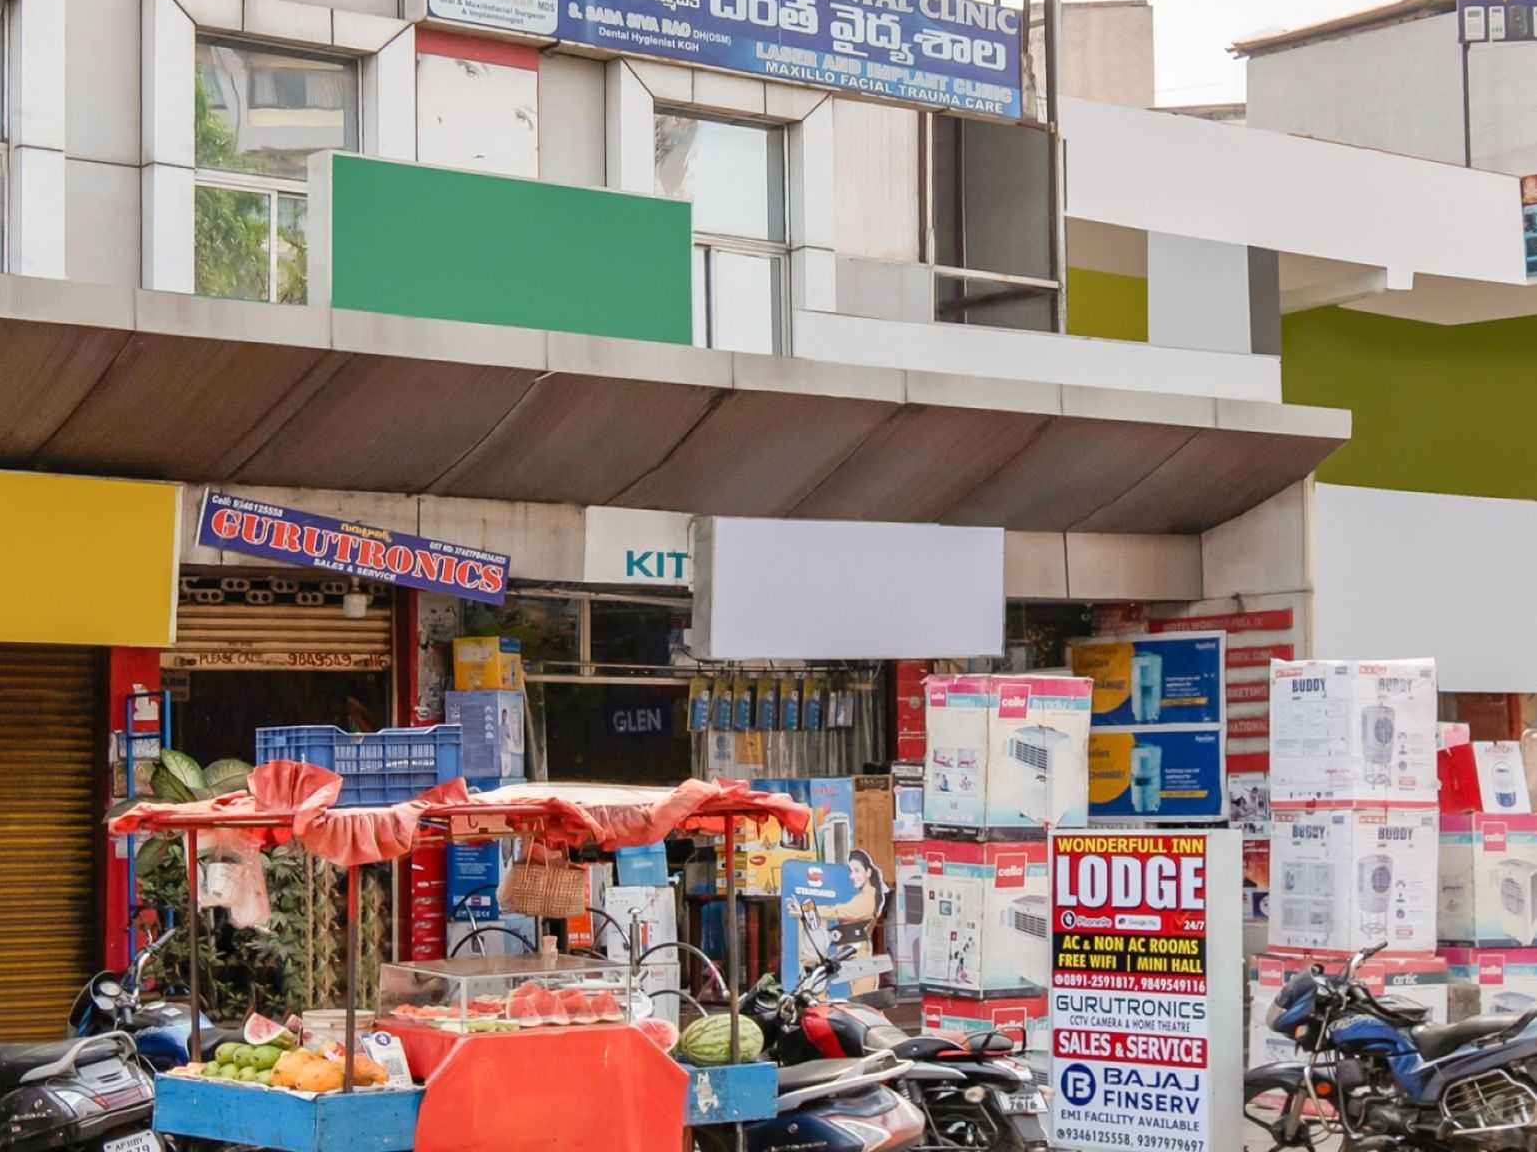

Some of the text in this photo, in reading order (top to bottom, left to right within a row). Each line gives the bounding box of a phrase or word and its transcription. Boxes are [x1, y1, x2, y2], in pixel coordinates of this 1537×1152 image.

[598, 26, 630, 41] Dental
[765, 61, 1004, 114] MAXILLO FACIAL TRAUMA CARE
[211, 507, 503, 593] GURUTRONICS
[313, 558, 345, 572] SALES
[1292, 678, 1327, 693] BUDDY
[1001, 695, 1026, 707] cello
[612, 706, 662, 732] GLEN
[1057, 837, 1204, 854] WONDERFULL INN
[998, 865, 1024, 877] cello
[1056, 853, 1205, 910] LODGE
[1184, 920, 1205, 931] 24/7
[1062, 935, 1081, 950] AC
[1094, 935, 1124, 952] NON
[1128, 937, 1146, 953] AC
[1149, 938, 1199, 955] ROOMS
[1058, 953, 1203, 973] FREE WIFI MINI HALL
[1140, 977, 1206, 993] 9849549116
[1056, 995, 1206, 1020] GURUTRONICS
[1069, 1015, 1088, 1026] CCTV
[1090, 1017, 1123, 1029] CAMERA
[1133, 1019, 1156, 1031] HOME
[1158, 1020, 1191, 1033] THEATRE
[1058, 1031, 1112, 1056] SALES
[1126, 1035, 1203, 1063] SERVICE
[1104, 1067, 1200, 1092] BAJAJ
[1104, 1090, 1200, 1115] FINSERV
[1061, 1109, 1200, 1132] EMI FACILITY AVAILABLE
[1137, 1135, 1204, 1152] 9397979697
